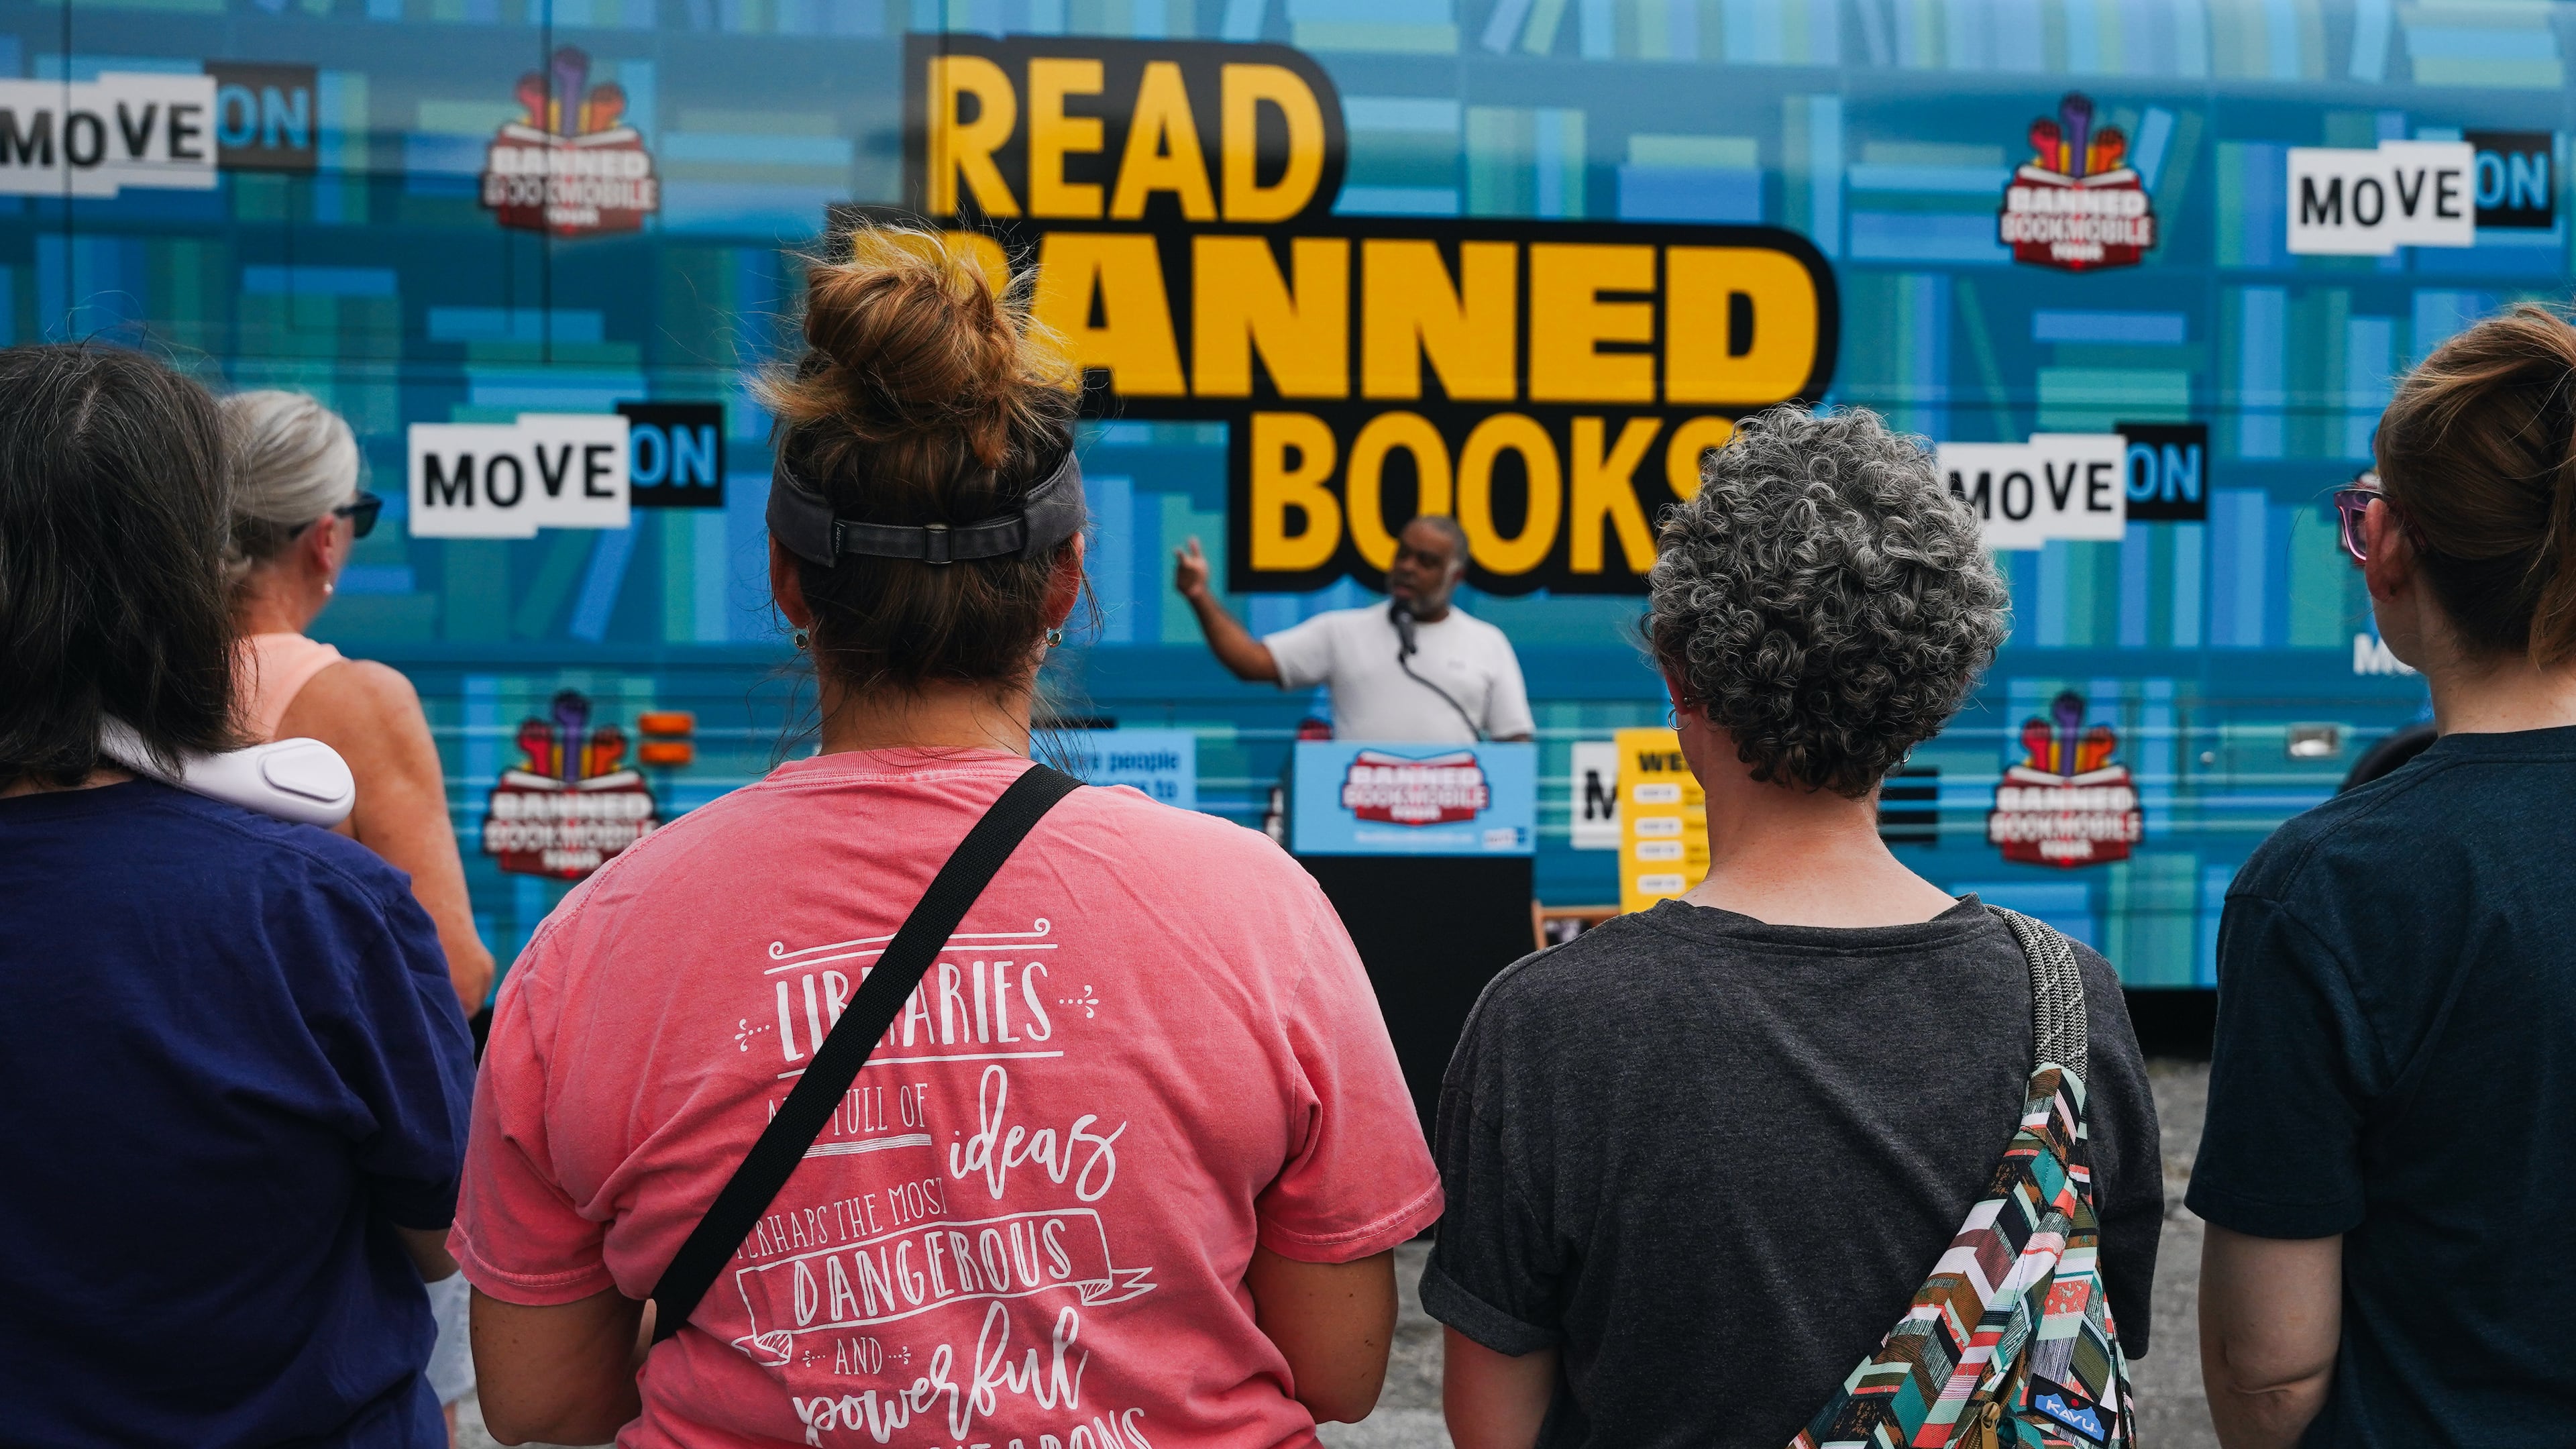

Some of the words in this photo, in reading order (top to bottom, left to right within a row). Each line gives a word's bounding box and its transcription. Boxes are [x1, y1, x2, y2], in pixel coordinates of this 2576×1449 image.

[0, 101, 204, 168] MOVE
[217, 84, 309, 150] ON
[928, 54, 1326, 223] READ
[491, 146, 650, 177] BANNED
[2008, 186, 2146, 217] BANNED
[2300, 167, 2462, 227] MOVE
[2475, 150, 2548, 209] ON
[2000, 213, 2153, 246] BOOKMOBILE
[423, 443, 615, 509] MOVE
[629, 423, 717, 488] ON
[1948, 462, 2113, 522] MOVE
[2126, 442, 2203, 503] ON
[1342, 784, 1488, 808] BOOKMOBILE
[1349, 766, 1484, 786] BANNED
[492, 792, 653, 821] BANNED
[1996, 786, 2136, 812] BANNED
[900, 1083, 928, 1128] OF
[949, 1064, 1127, 1201] ideas
[834, 1193, 883, 1240] THE
[888, 1177, 948, 1225] MOST
[792, 1218, 1073, 1326] DANGEROUS
[792, 1299, 1089, 1448] powerful
[834, 1336, 883, 1376] AND
[2045, 1399, 2095, 1432] KAVU
